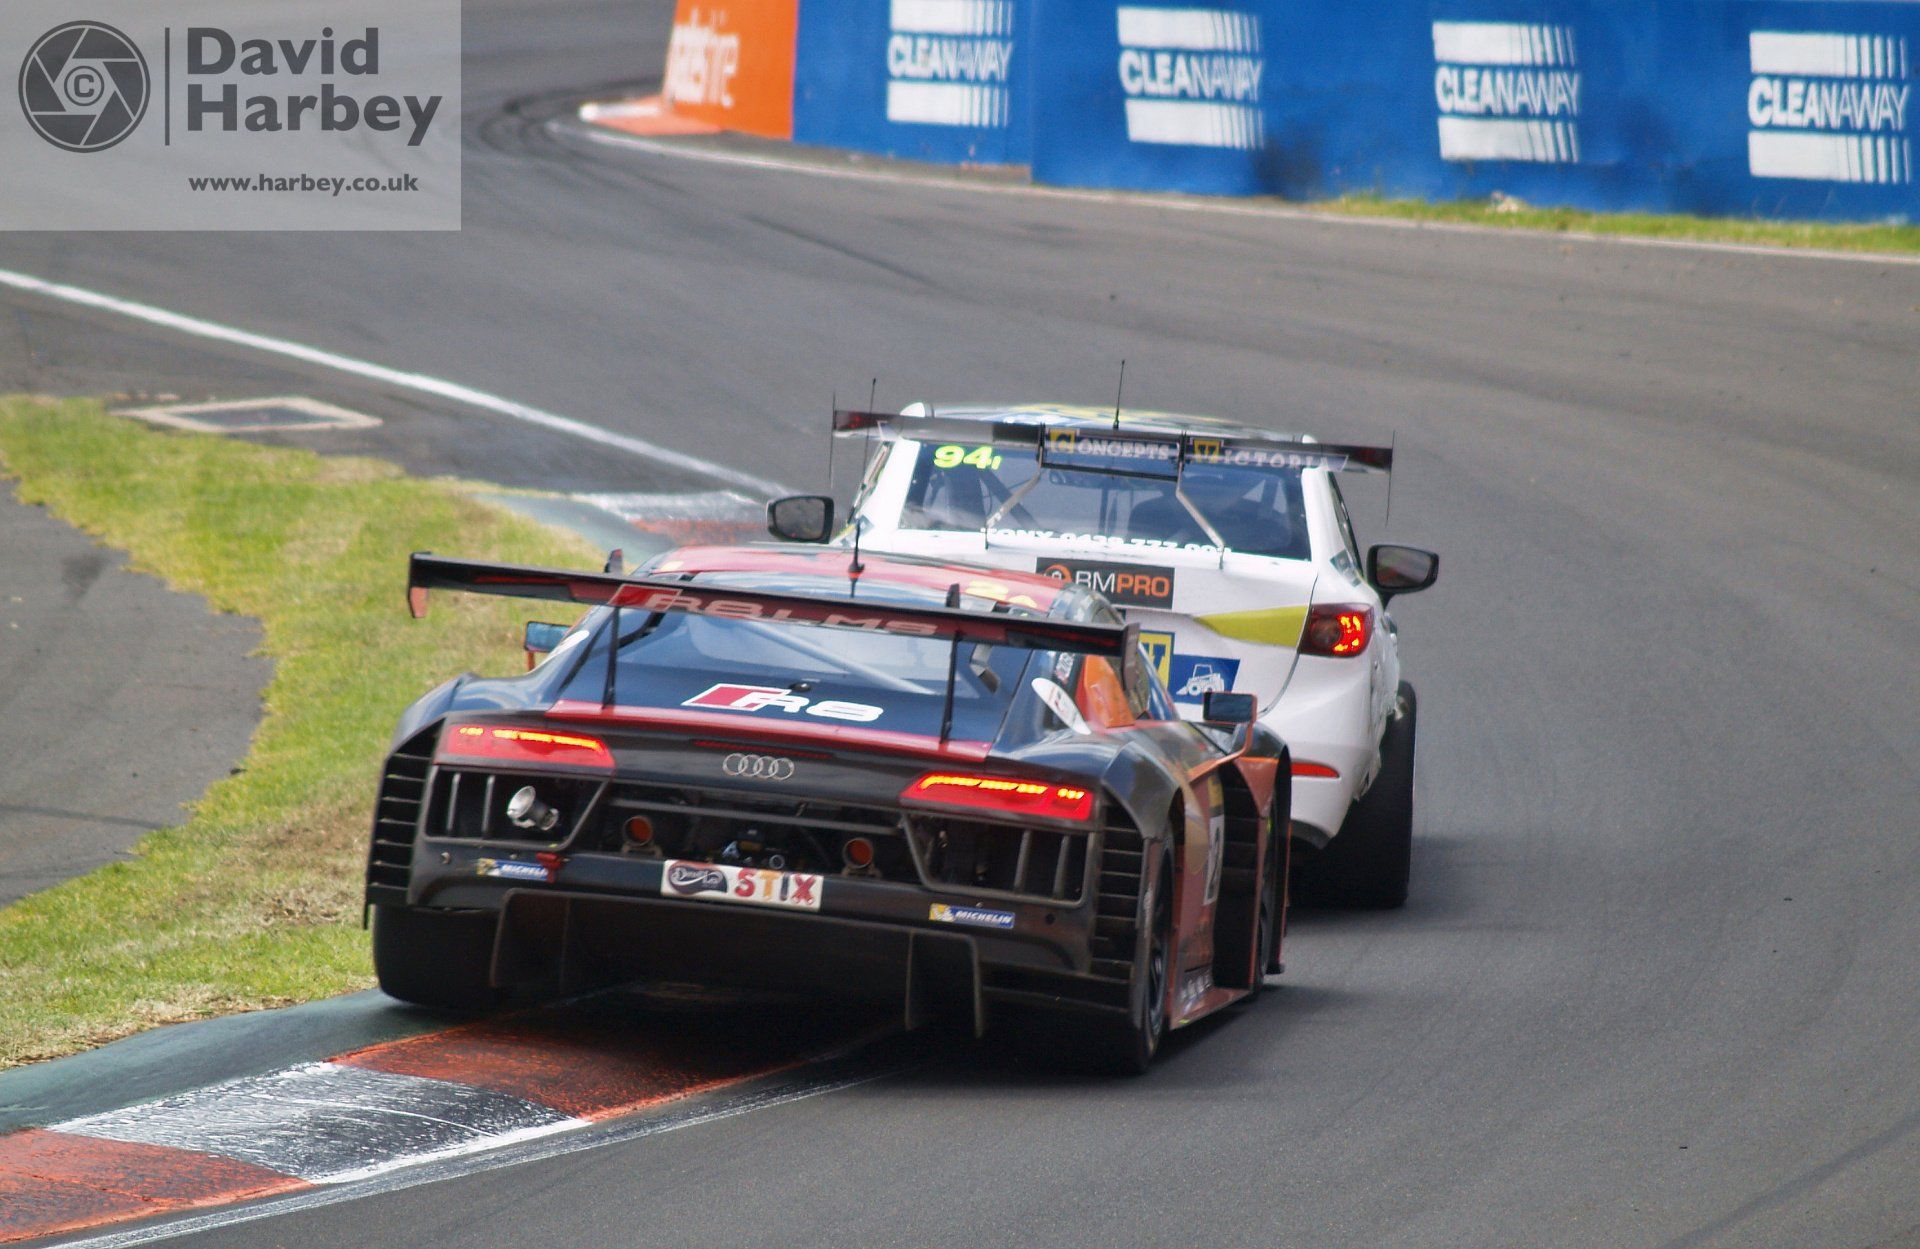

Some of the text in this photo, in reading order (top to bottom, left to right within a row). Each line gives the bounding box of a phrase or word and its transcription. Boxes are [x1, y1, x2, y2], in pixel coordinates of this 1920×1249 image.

[887, 34, 1012, 82] CLEANAWAY
[1119, 49, 1263, 103] CLEANAWAY
[1434, 65, 1580, 116] CLEANAWAY
[1747, 77, 1909, 131] CLEANAWAY
[728, 687, 884, 722] R8
[735, 867, 817, 906] STIX
[954, 910, 1013, 924] MICHELIN
